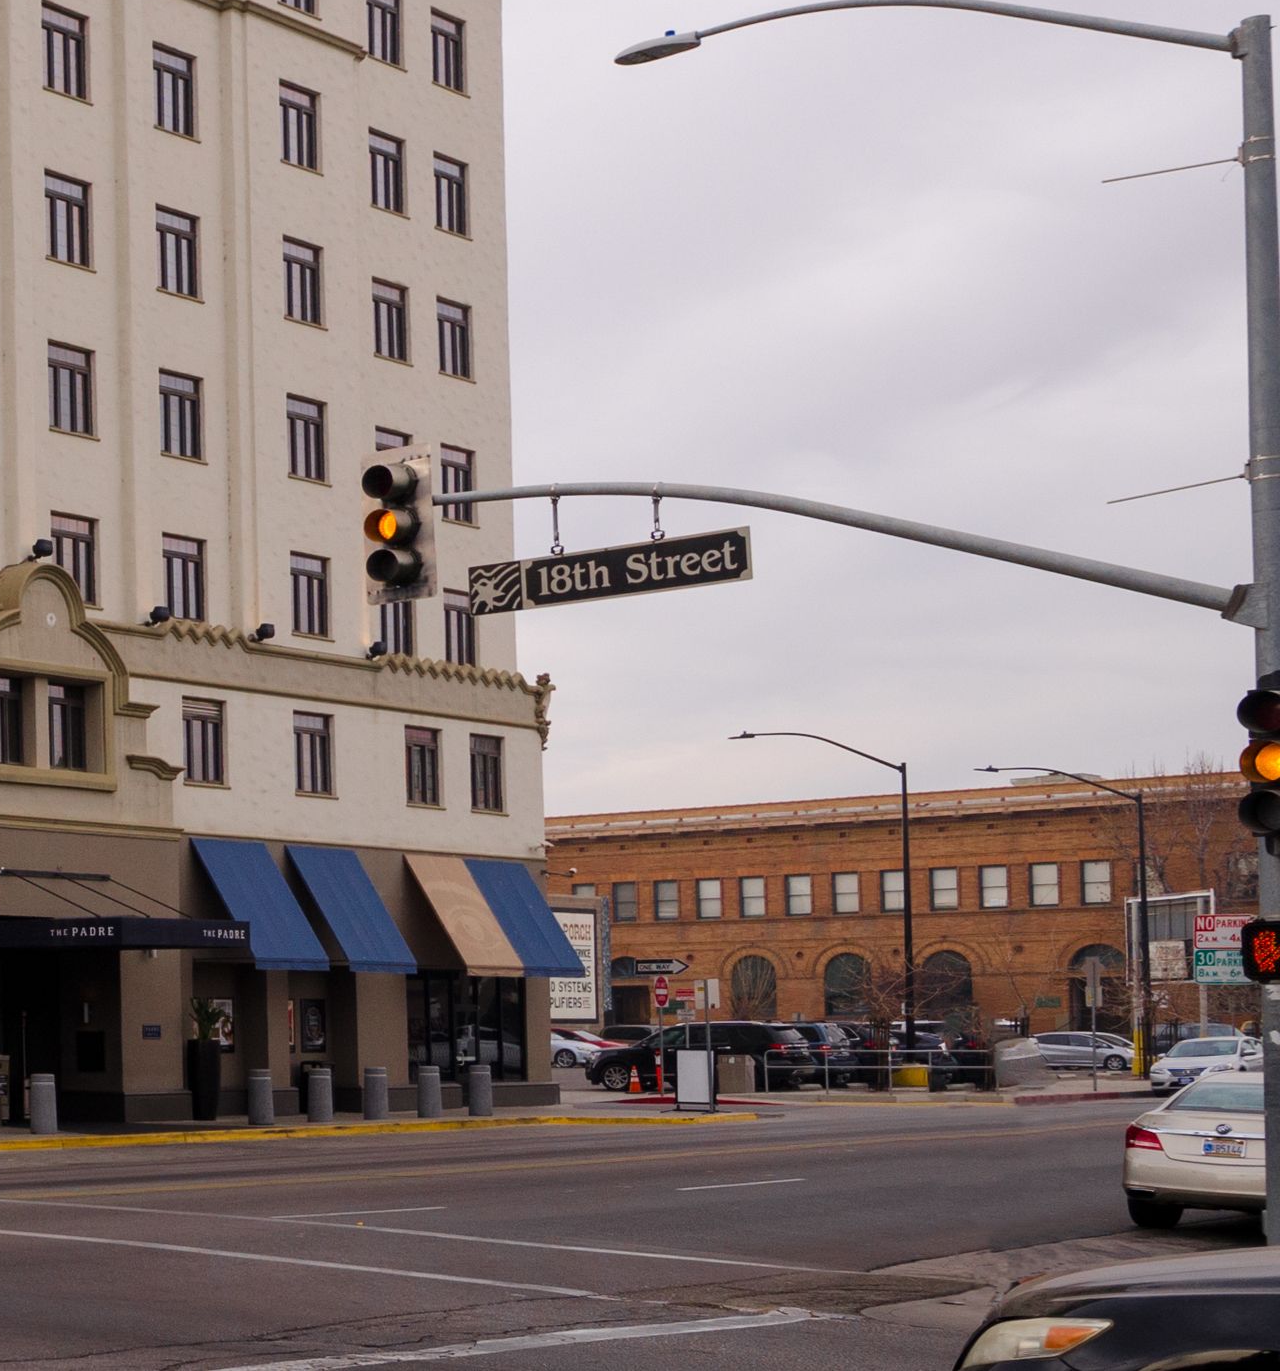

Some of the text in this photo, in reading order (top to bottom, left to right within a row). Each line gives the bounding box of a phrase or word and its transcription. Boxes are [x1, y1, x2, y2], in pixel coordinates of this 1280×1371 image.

[537, 540, 739, 597] 18th Street
[1196, 916, 1248, 931] NO PARKIN
[50, 926, 115, 937] THE PADRE
[203, 929, 246, 940] THE PADRE
[1198, 952, 1242, 966] 30 PARKI
[639, 963, 653, 971] ONE
[559, 981, 592, 993] SYSTEMS
[550, 997, 582, 1009] PLIFIERS
